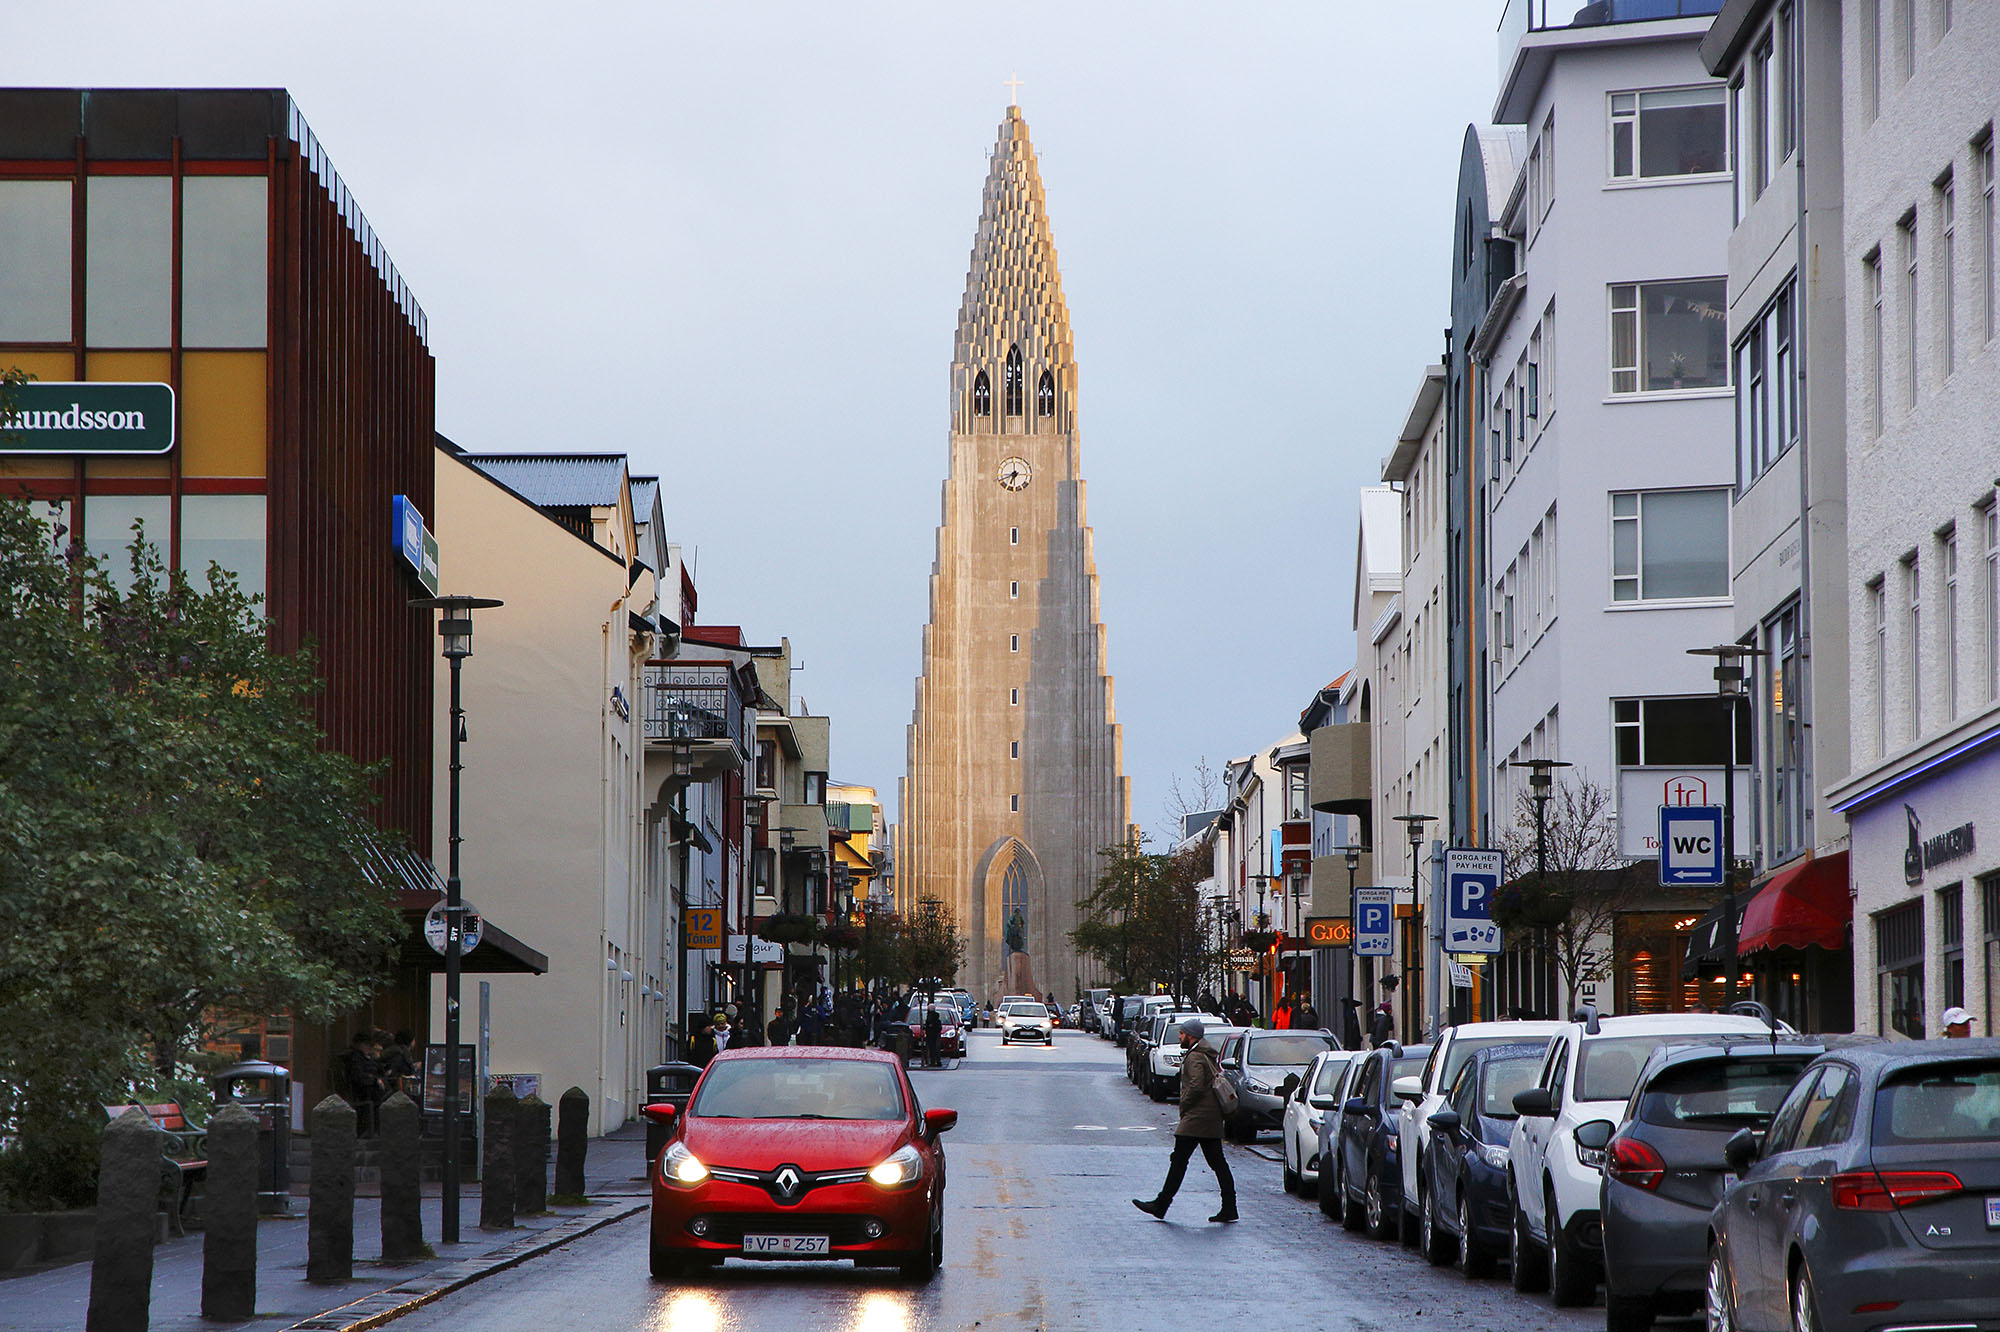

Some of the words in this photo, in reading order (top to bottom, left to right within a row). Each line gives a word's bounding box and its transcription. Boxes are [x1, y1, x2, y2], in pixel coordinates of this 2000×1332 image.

[1673, 836, 1712, 854] WC
[1462, 881, 1485, 911] P
[1478, 902, 1484, 911] 1
[691, 913, 713, 931] 12
[1366, 908, 1382, 929] P
[687, 933, 718, 945] Tónar
[735, 943, 773, 955] Sgur
[1926, 1224, 1952, 1236] A3
[756, 1237, 780, 1251] VP
[794, 1238, 827, 1252] Z57
